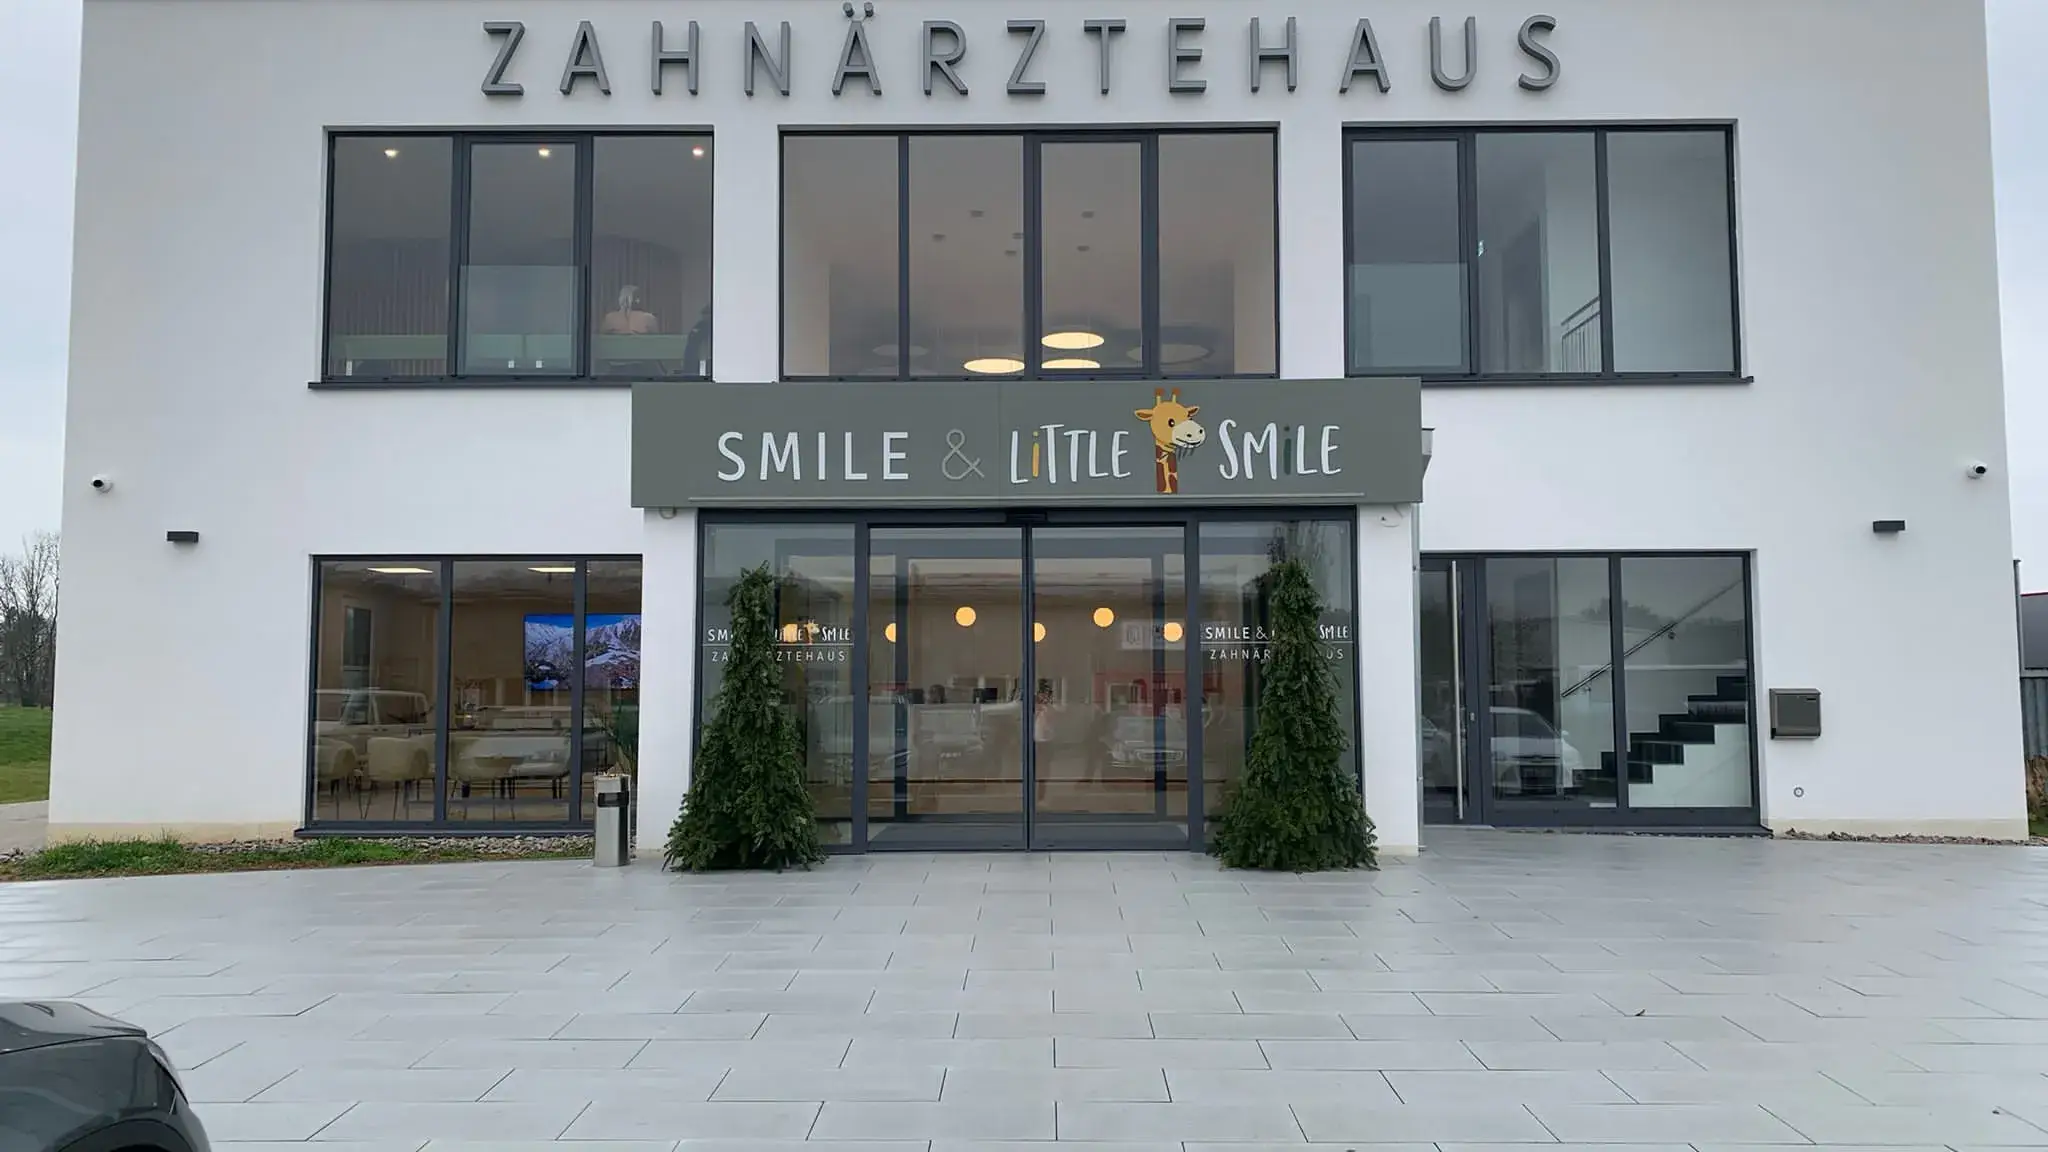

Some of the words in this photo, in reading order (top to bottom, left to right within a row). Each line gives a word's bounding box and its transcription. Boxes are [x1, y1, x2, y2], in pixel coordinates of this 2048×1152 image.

[481, 2, 1560, 96] ZAHNÄRZTEHAUS
[717, 431, 909, 480] SMILE
[942, 429, 985, 479] &
[1205, 626, 1250, 639] SMILE
[1256, 625, 1268, 640] &
[711, 650, 845, 662] ZAZTEHAUS
[1209, 648, 1344, 660] ZAHNÄRUS
